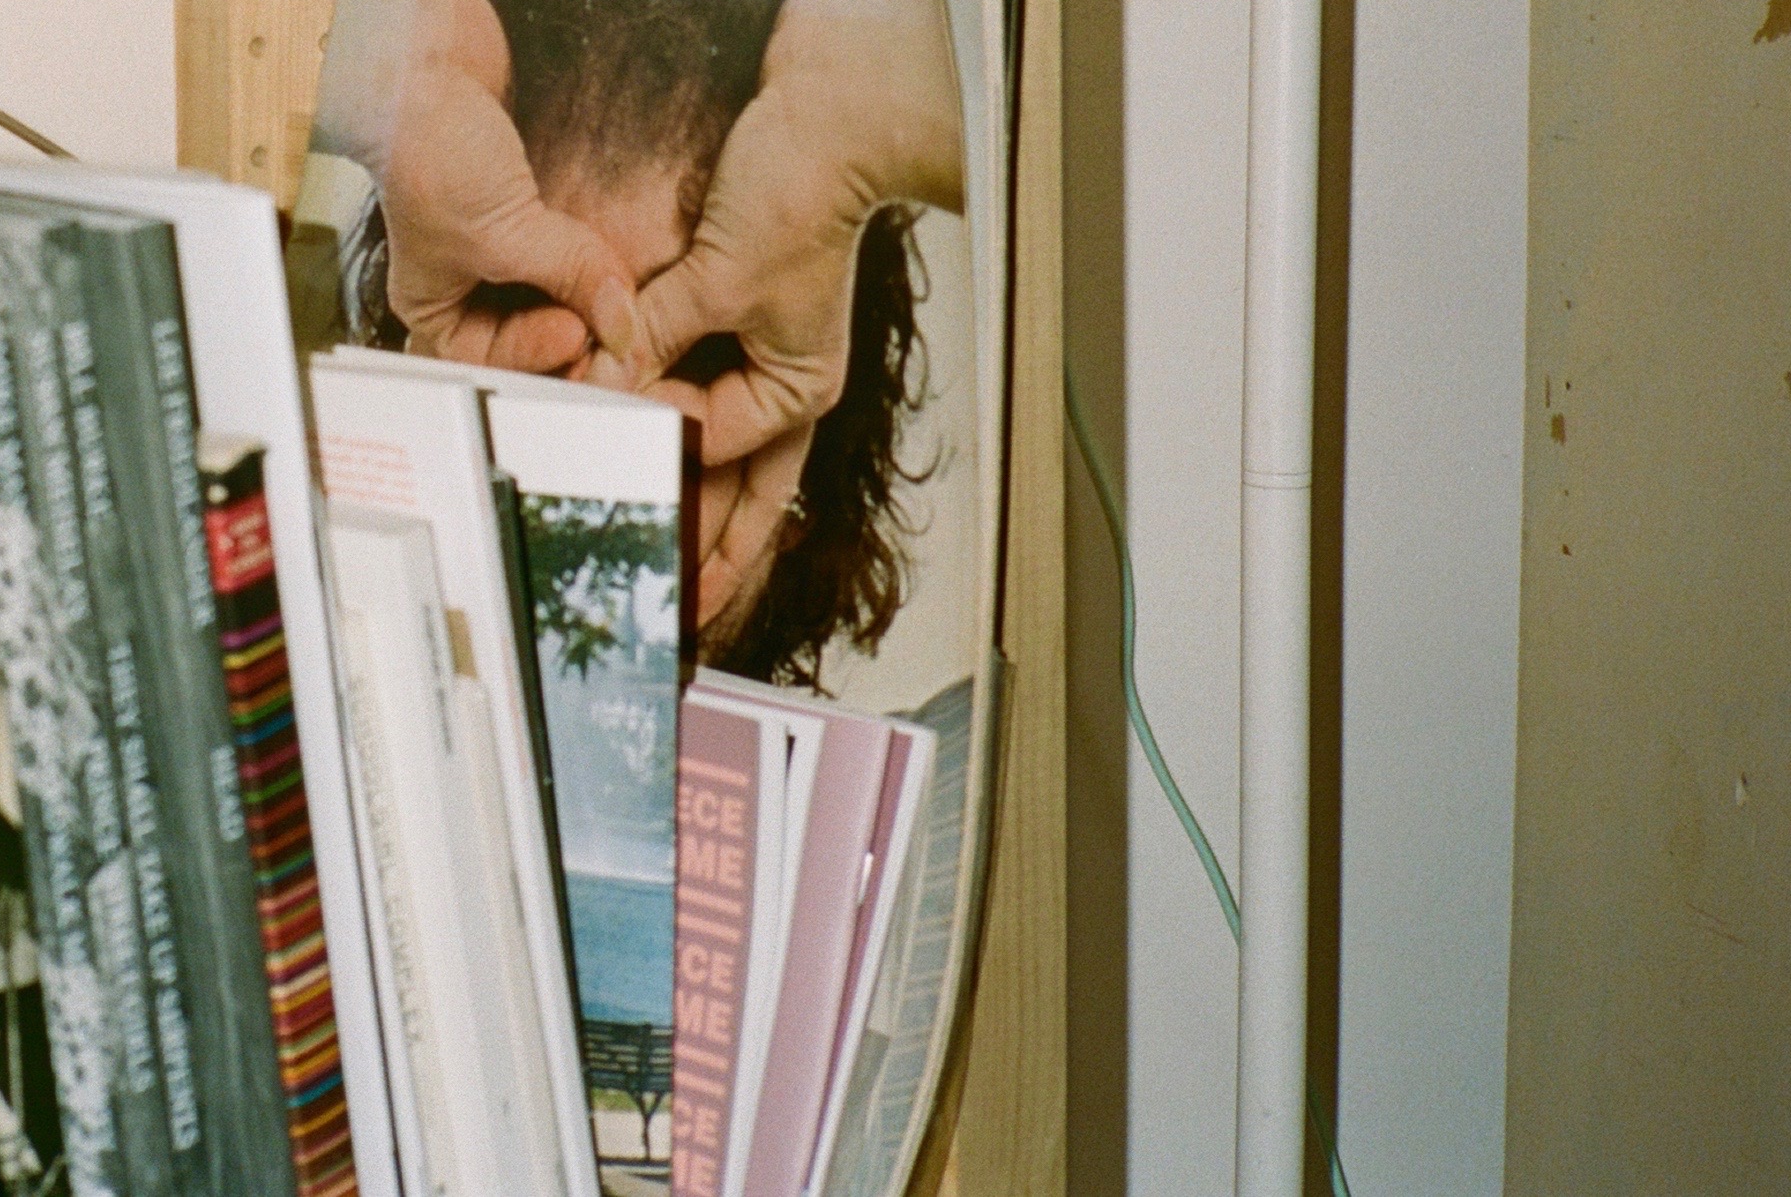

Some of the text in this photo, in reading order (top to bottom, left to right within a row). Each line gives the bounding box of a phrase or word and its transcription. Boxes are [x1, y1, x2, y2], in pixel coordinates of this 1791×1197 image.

[108, 639, 141, 728] THEY
[119, 734, 157, 845] SHALL
[210, 743, 245, 843] HEAD
[136, 847, 171, 936] TAKE
[149, 938, 177, 986] UP
[678, 941, 736, 995] CE
